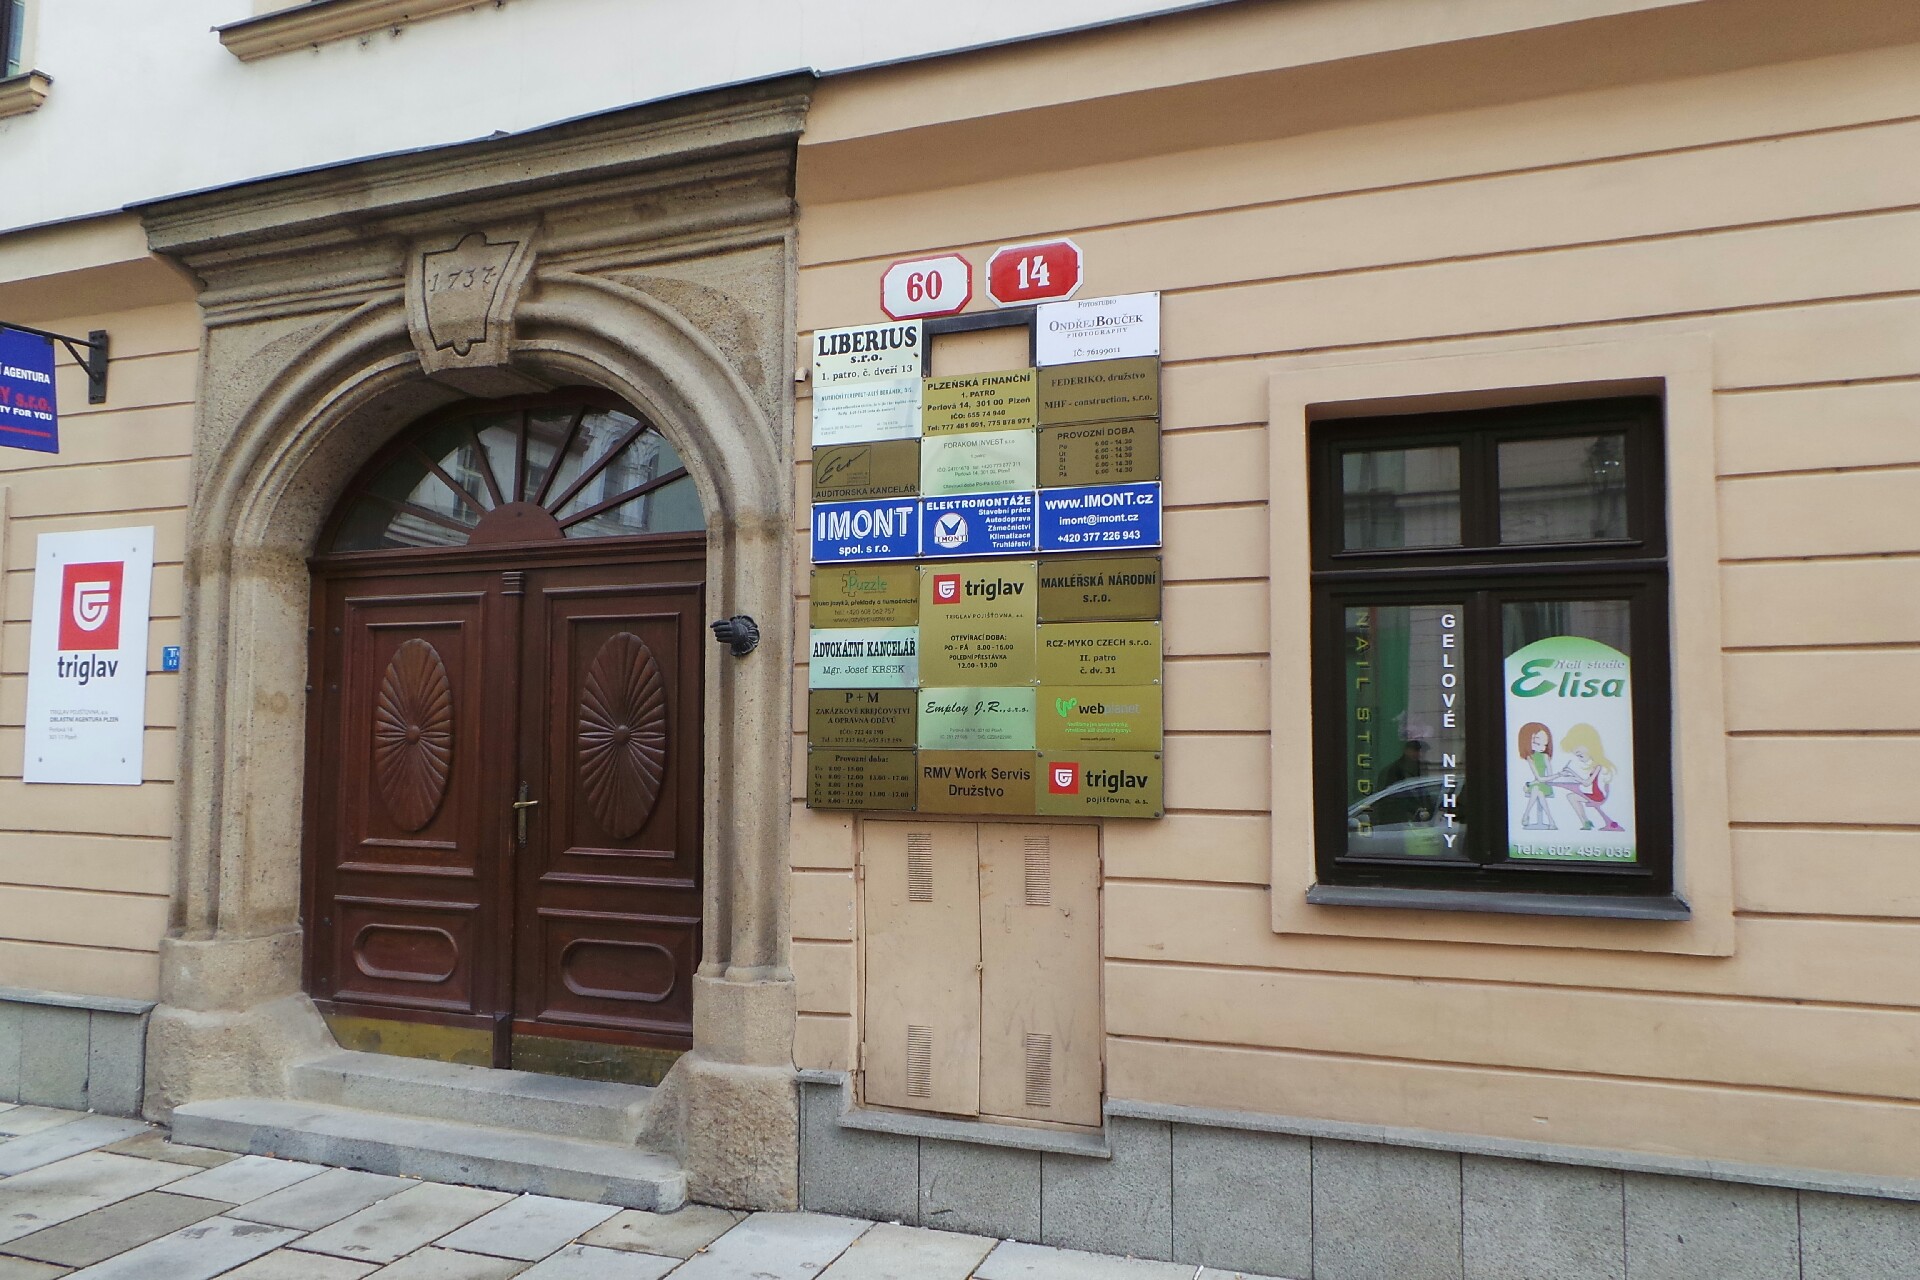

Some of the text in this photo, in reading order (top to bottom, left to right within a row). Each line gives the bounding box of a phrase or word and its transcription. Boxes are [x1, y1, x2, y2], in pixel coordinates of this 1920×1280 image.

[1017, 255, 1050, 289] 14
[906, 270, 943, 302] 60
[1067, 327, 1128, 339] PHOTOGRAPHY
[818, 326, 917, 356] LIBERIUS
[851, 353, 882, 364] s.r.o.
[1087, 347, 1120, 356] 76199011
[3, 366, 51, 384] AGENTURA
[863, 368, 870, 377] č.
[874, 365, 897, 376] dveří
[902, 365, 913, 373] 13
[1108, 372, 1146, 382] družstvo
[927, 372, 1031, 391] PLZEŇSKÁ FINANČNÍ
[970, 390, 996, 398] PATRO
[15, 393, 51, 411] s.r.o.
[927, 403, 957, 411] Perlová
[1008, 396, 1031, 404] Plzeň
[1044, 400, 1066, 410] MHF
[1074, 395, 1130, 407] construction,
[13, 407, 32, 418] FOR
[34, 411, 53, 421] YOU
[1057, 427, 1135, 440] PROVOZNÍ DOBA
[943, 438, 1004, 449] FORAKOM INVEST
[927, 495, 1031, 511] ELEKTROMONTÁŽE
[1045, 492, 1153, 510] www.IMONT.cz
[979, 507, 1031, 516] Stavební práce
[818, 507, 913, 541] IMONT
[985, 516, 1031, 524] Autodoprava
[1059, 513, 1139, 525] imont@imont.cz
[988, 524, 1031, 532] Zámečnictví
[937, 535, 968, 543] IMONT
[1058, 530, 1140, 543] +420 377 226 943
[839, 545, 863, 556] spol.
[875, 545, 891, 553] r.o.
[849, 575, 888, 591] Puzzle
[1041, 571, 1156, 588] MAKLÉŘSKÁ NÁRODNÍ
[965, 578, 1024, 601] triglav
[1083, 594, 1111, 602] s.r.o.
[813, 638, 916, 657] ADVOKÁTNÍ KANCELÁŘ
[1046, 639, 1094, 647] RCZ-MYKO
[1096, 639, 1126, 647] CZECH
[1080, 654, 1091, 662] II.
[1356, 612, 1370, 691] NAIL
[57, 654, 119, 685] triglav
[823, 666, 842, 676] Mgr.
[845, 665, 868, 674] Josef
[1441, 614, 1456, 728] GELOVÉ
[1587, 659, 1625, 669] studio
[1510, 658, 1625, 698] Elisa
[845, 692, 879, 703] P M
[815, 707, 859, 715] ZAKÁZKOVÉ
[925, 701, 969, 715] Employ
[924, 766, 1031, 780] RMV Work Servis
[1085, 770, 1148, 793] triglav
[949, 784, 1004, 797] Družstvo
[1442, 753, 1457, 848] NEHTY
[1514, 844, 1631, 858] Tel.: 602 495 035
